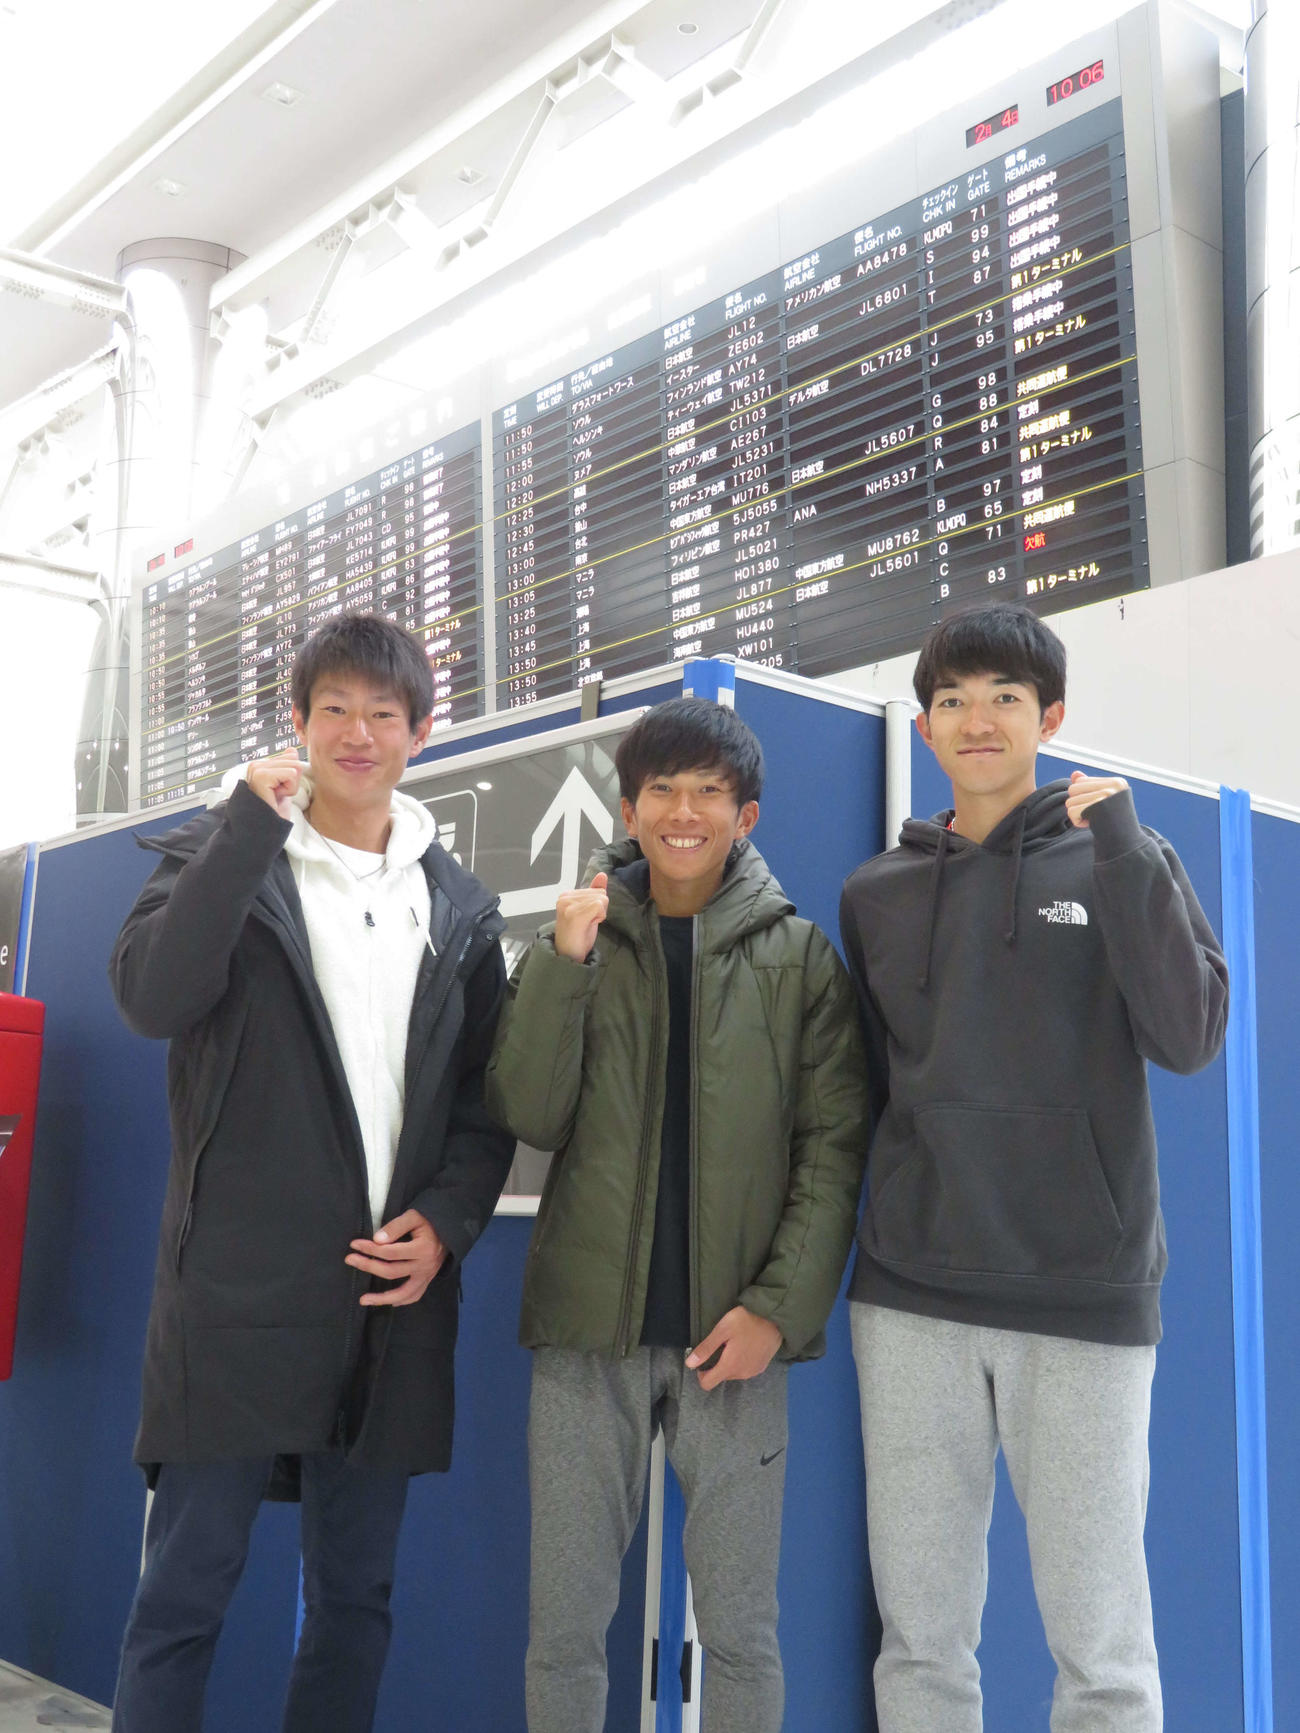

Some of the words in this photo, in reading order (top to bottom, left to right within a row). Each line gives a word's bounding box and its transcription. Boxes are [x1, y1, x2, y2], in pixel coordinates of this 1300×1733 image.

[1051, 79, 1073, 104] 10
[1079, 61, 1104, 89] 06
[1005, 154, 1046, 183] REMARKS
[968, 169, 988, 187] ゲート
[922, 185, 958, 209] チェックイン
[968, 181, 990, 200] GATE
[923, 207, 942, 222] CHK
[946, 200, 955, 211] IN
[971, 205, 985, 221] 71
[971, 225, 989, 242] 99
[854, 233, 884, 257] FLIGHT
[972, 245, 989, 263] 94
[857, 243, 907, 277] AA8478
[926, 251, 934, 264] S
[784, 269, 815, 292] AIRLINE
[929, 271, 933, 283] I
[974, 266, 990, 283] 87
[859, 284, 907, 315] JL6801
[928, 290, 936, 304] T
[725, 297, 752, 320] FLIGHT
[976, 309, 993, 327] 73
[728, 317, 755, 339] JL12
[664, 330, 691, 350] AIRLINE
[728, 332, 763, 358] ZE602
[931, 333, 937, 346] J
[976, 330, 994, 348] 95
[728, 353, 757, 376] AY74
[861, 344, 911, 376] DL7728
[932, 353, 938, 366] J
[666, 364, 699, 385] イースター
[729, 369, 765, 393] TW212
[978, 372, 996, 390] 98
[730, 385, 772, 412] JL5371
[932, 394, 941, 408] G
[979, 393, 997, 410] 88
[730, 407, 766, 432] CI103
[933, 415, 942, 428] Q
[980, 416, 998, 433] 84
[506, 425, 532, 445] 11:50
[730, 426, 766, 450] AE267
[865, 425, 914, 455] JL5607
[934, 437, 942, 450] R
[506, 441, 532, 461] 11:50
[982, 438, 997, 454] 81
[732, 442, 773, 469] JL5231
[935, 458, 944, 471] A
[506, 458, 532, 478] 11:55
[734, 464, 766, 487] IT201
[506, 474, 532, 494] 12:00
[866, 467, 916, 496] NH5337
[983, 480, 1000, 496] 97
[507, 490, 533, 510] 12:20
[732, 482, 768, 507] MU776
[734, 499, 777, 526] 5J5055
[794, 505, 817, 522] ANA
[937, 499, 945, 512] B
[984, 501, 1002, 517] 65
[507, 508, 533, 526] 12:25
[405, 528, 414, 538] 99
[507, 524, 533, 542] 12:30
[734, 521, 770, 544] PR427
[986, 525, 1001, 540] 71
[405, 543, 414, 554] 99
[508, 540, 534, 559] 12:45
[735, 538, 777, 563] JL5021
[868, 529, 919, 556] MU8762
[939, 542, 948, 555] Q
[1025, 533, 1046, 552] 欠航
[508, 557, 534, 575] 13:00
[734, 557, 779, 582] HO1380
[870, 551, 918, 577] JL5601
[940, 563, 948, 576] C
[508, 574, 535, 591] 13:00
[576, 569, 594, 583] マニラ
[988, 567, 1006, 583] 83
[406, 590, 415, 600] 92
[576, 586, 594, 600] マニラ
[737, 578, 772, 600] JL877
[941, 584, 950, 597] B
[508, 591, 535, 608] 13:05
[406, 605, 414, 615] 81
[509, 607, 535, 625] 13:25
[736, 599, 773, 621] MU524
[406, 620, 415, 630] 65
[509, 624, 535, 642] 13:40
[736, 618, 773, 639] HU440
[509, 640, 536, 658] 13:45
[738, 638, 774, 658] XW101
[509, 658, 536, 674] 13:50
[510, 675, 536, 692] 13:50
[510, 692, 537, 708] 13:55
[1039, 908, 1071, 916] NORTH
[1053, 901, 1071, 909] THE
